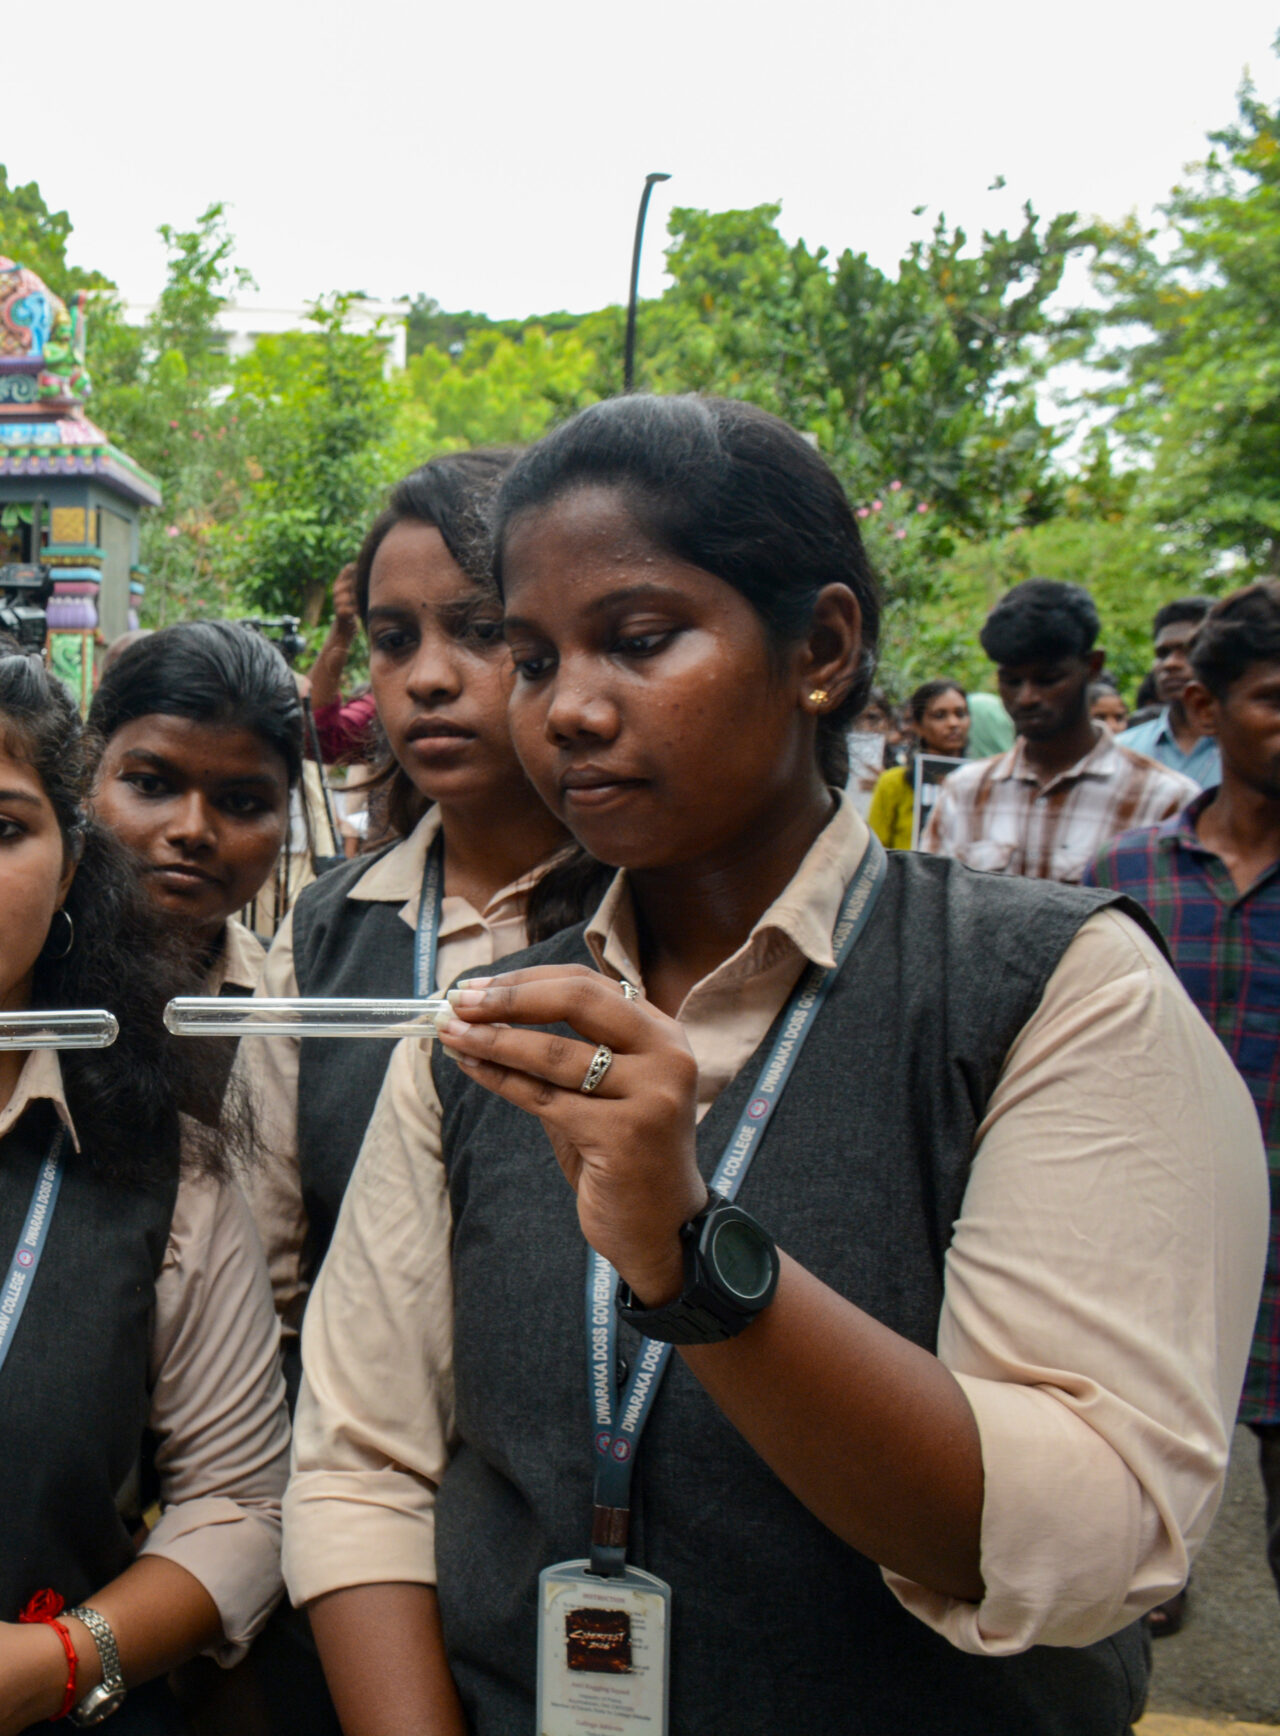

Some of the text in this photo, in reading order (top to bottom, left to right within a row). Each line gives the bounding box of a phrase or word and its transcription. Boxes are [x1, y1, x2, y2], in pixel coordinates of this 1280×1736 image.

[832, 920, 854, 949] DOSS
[761, 1039, 794, 1093] DWARAKA
[785, 1009, 809, 1041] DOSS
[723, 1124, 757, 1177] COLLEGE
[24, 1202, 48, 1247] DWARAKA
[36, 1180, 53, 1204] DOSS
[1, 1270, 26, 1315] COLLEGE
[592, 1326, 609, 1361] DOSS
[593, 1362, 612, 1425] DWARAKA
[621, 1338, 666, 1433] DWARAKA DOSS
